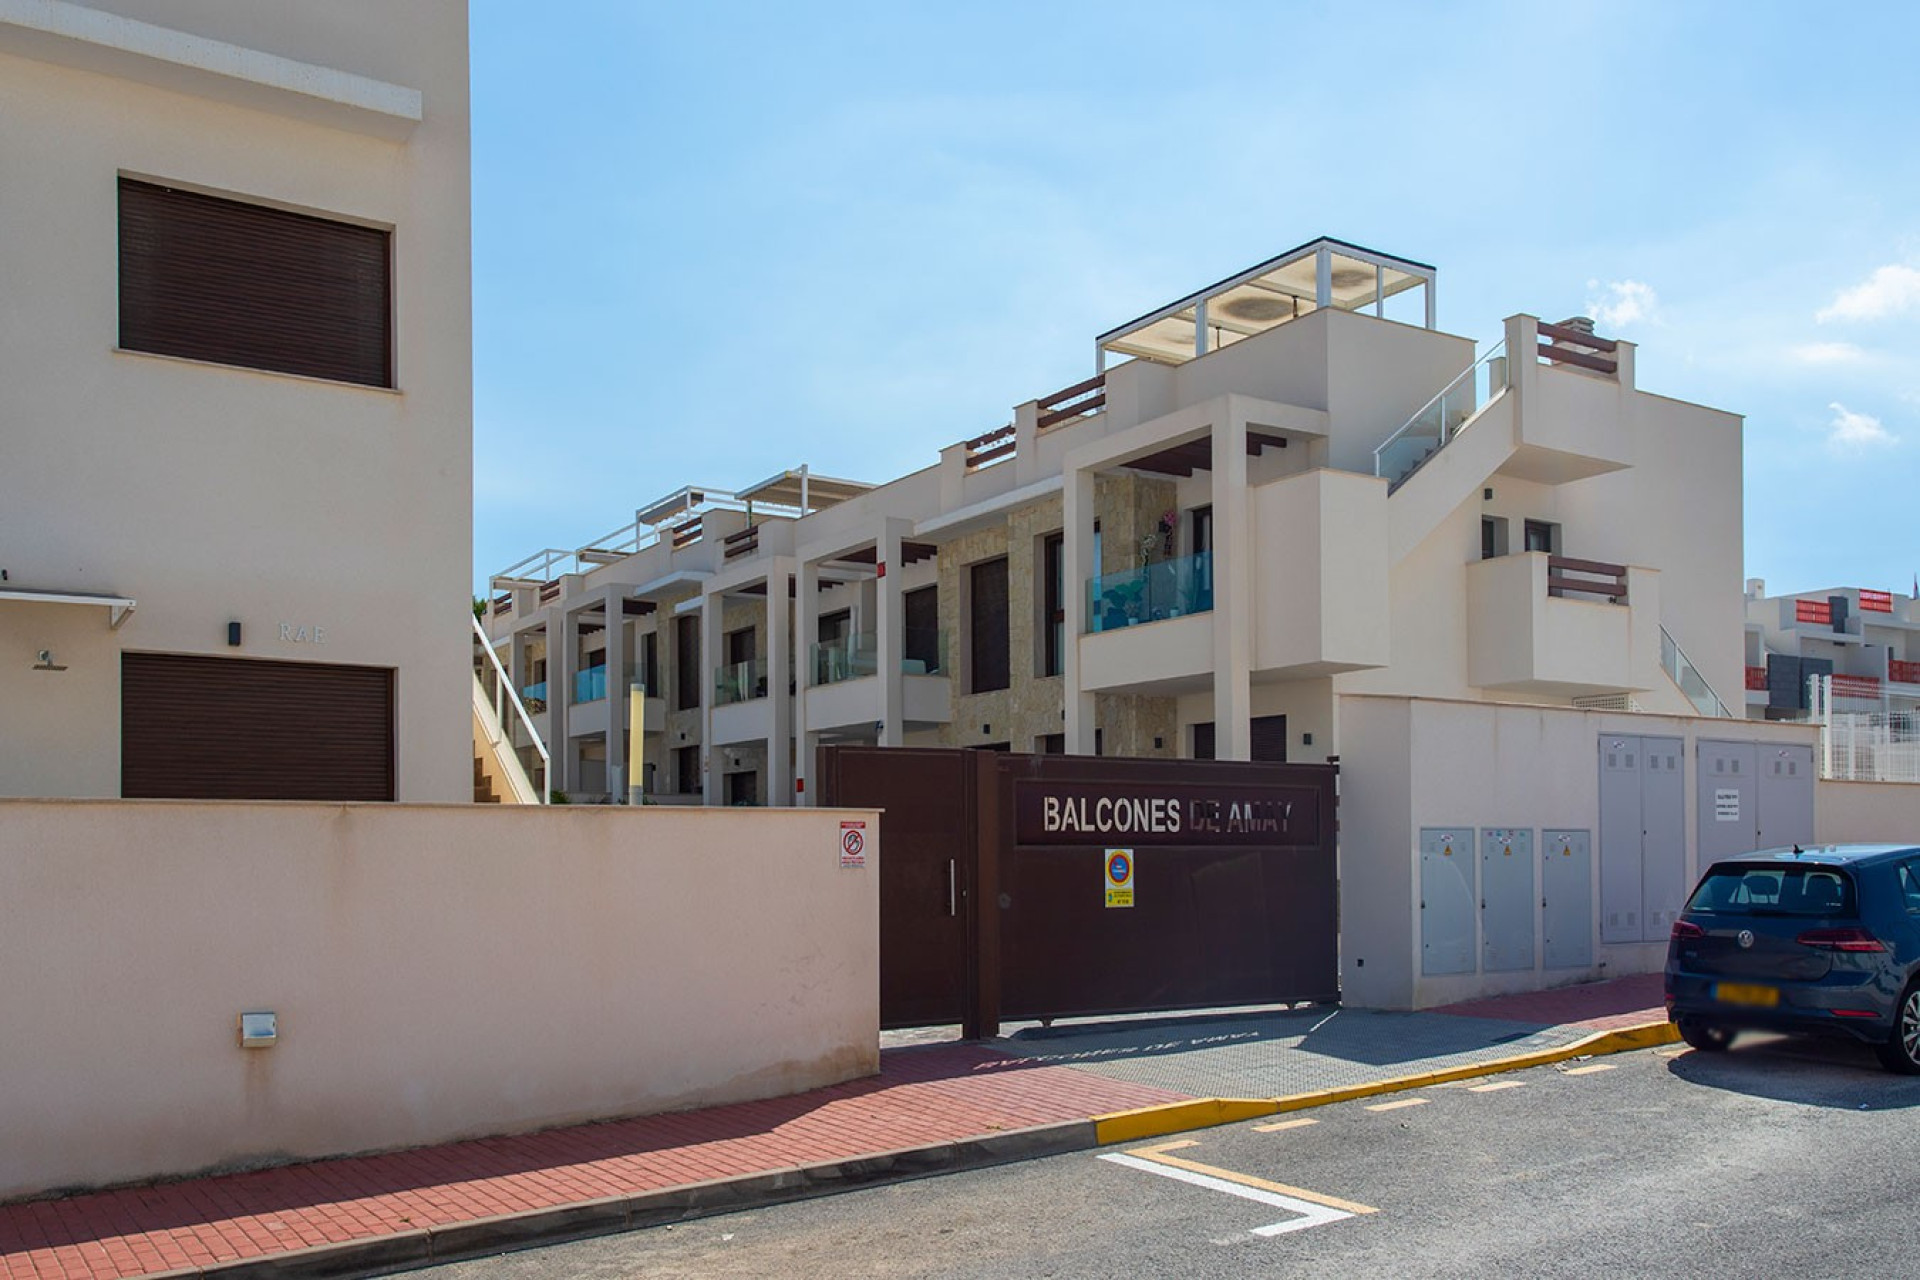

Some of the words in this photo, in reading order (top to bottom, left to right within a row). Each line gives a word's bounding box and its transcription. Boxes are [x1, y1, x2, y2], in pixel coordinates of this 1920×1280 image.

[279, 622, 328, 644] RAE
[1043, 796, 1180, 833] BALCONES
[1189, 798, 1220, 832] DE
[1226, 800, 1292, 832] AMAY
